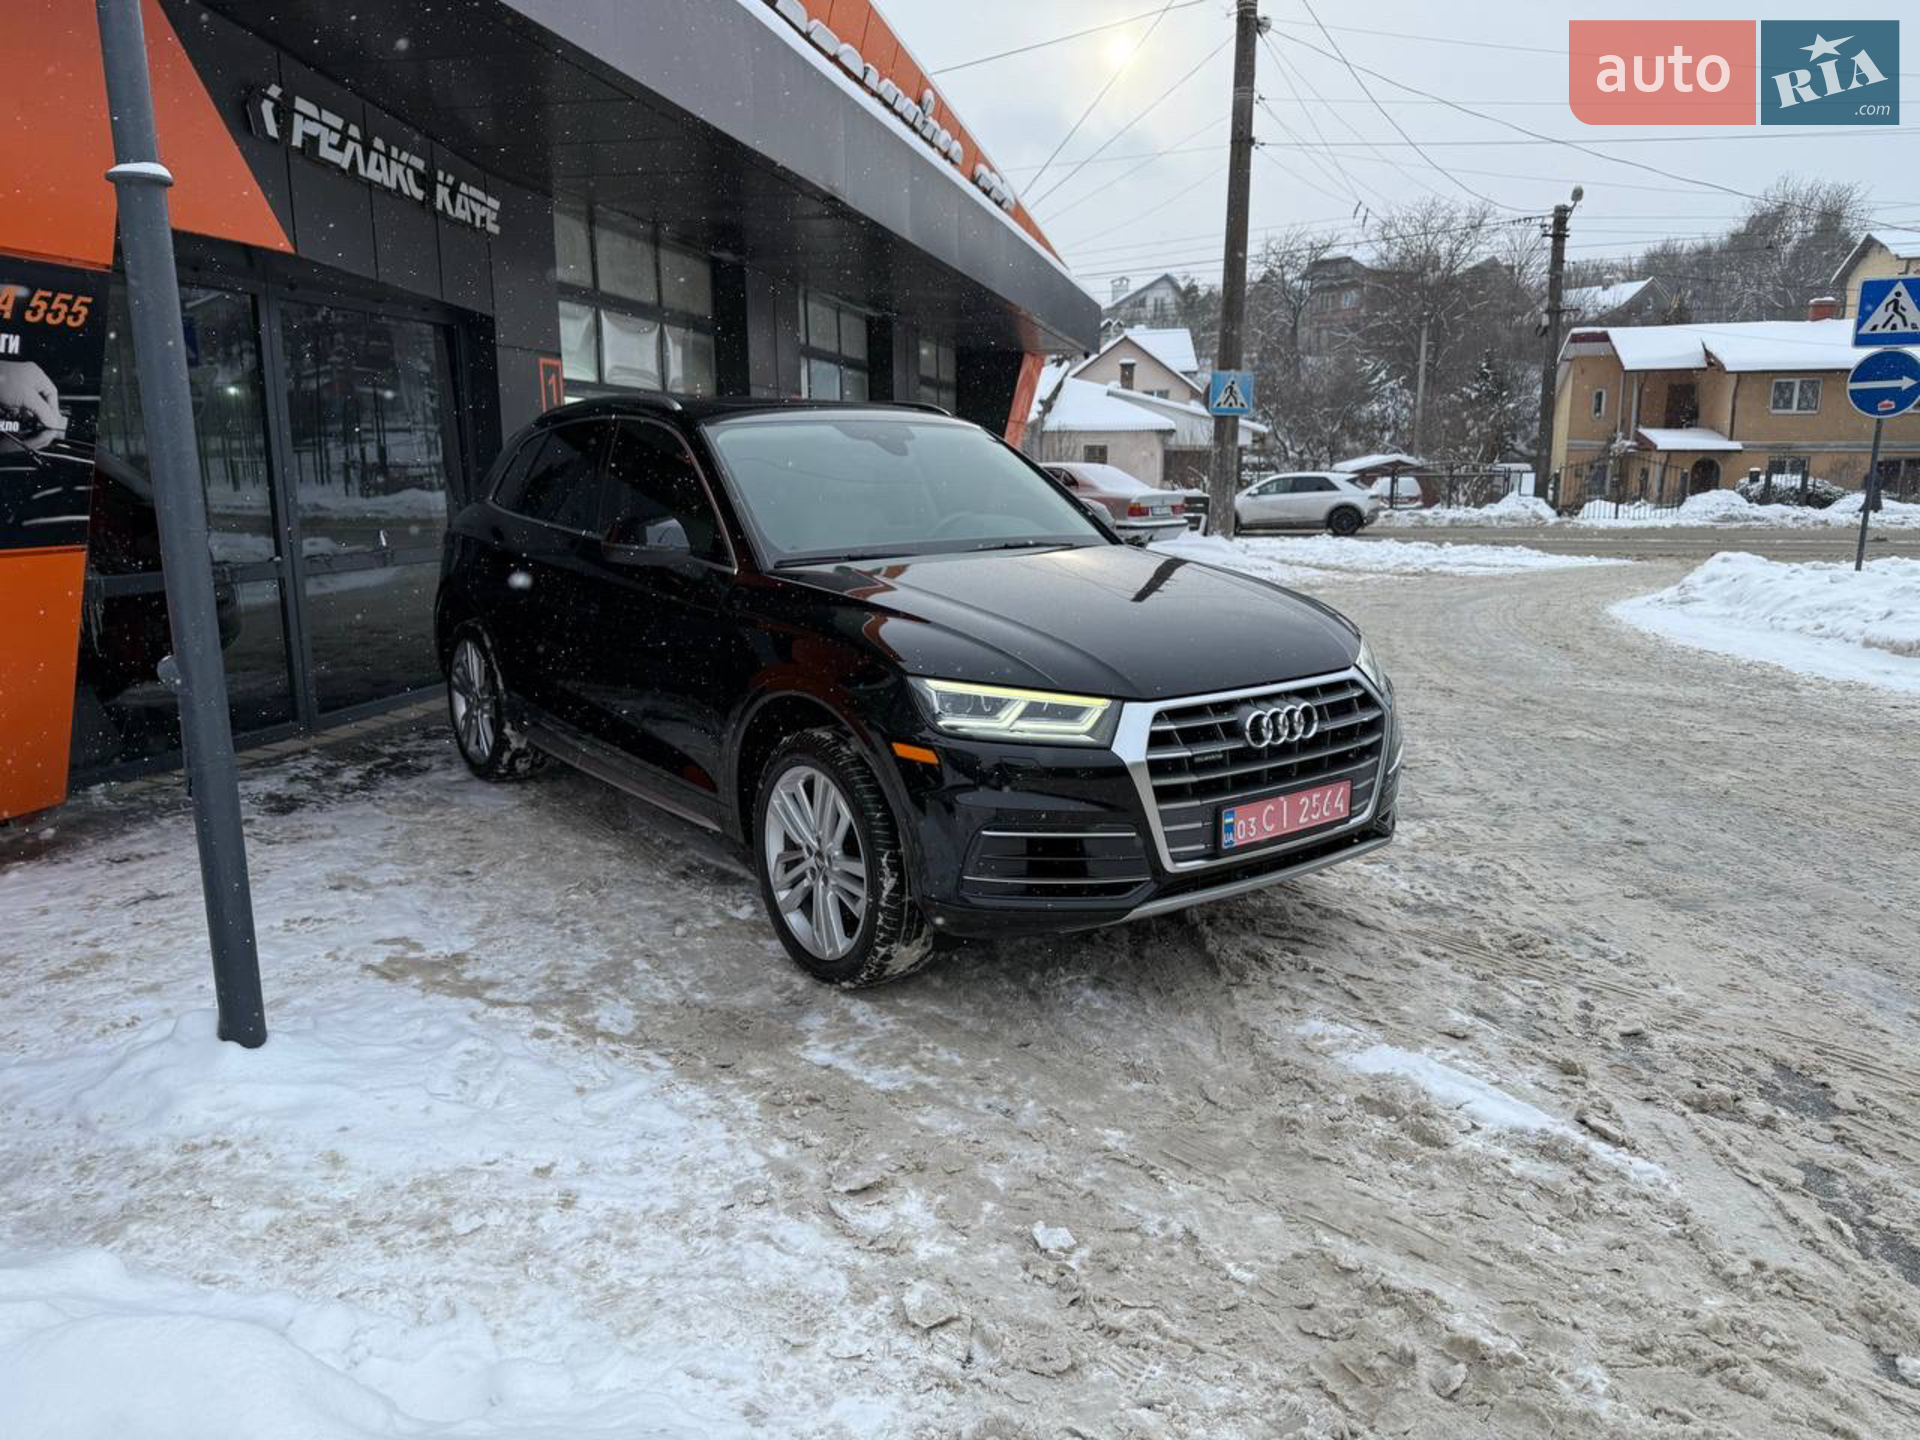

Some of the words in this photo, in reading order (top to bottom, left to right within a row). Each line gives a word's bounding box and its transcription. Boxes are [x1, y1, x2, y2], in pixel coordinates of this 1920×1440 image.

[291, 95, 426, 201] РЕЛАКС
[435, 170, 501, 235] КАФЕ
[24, 289, 94, 328] 555
[1236, 816, 1257, 840] 03
[1298, 786, 1345, 824] 2564
